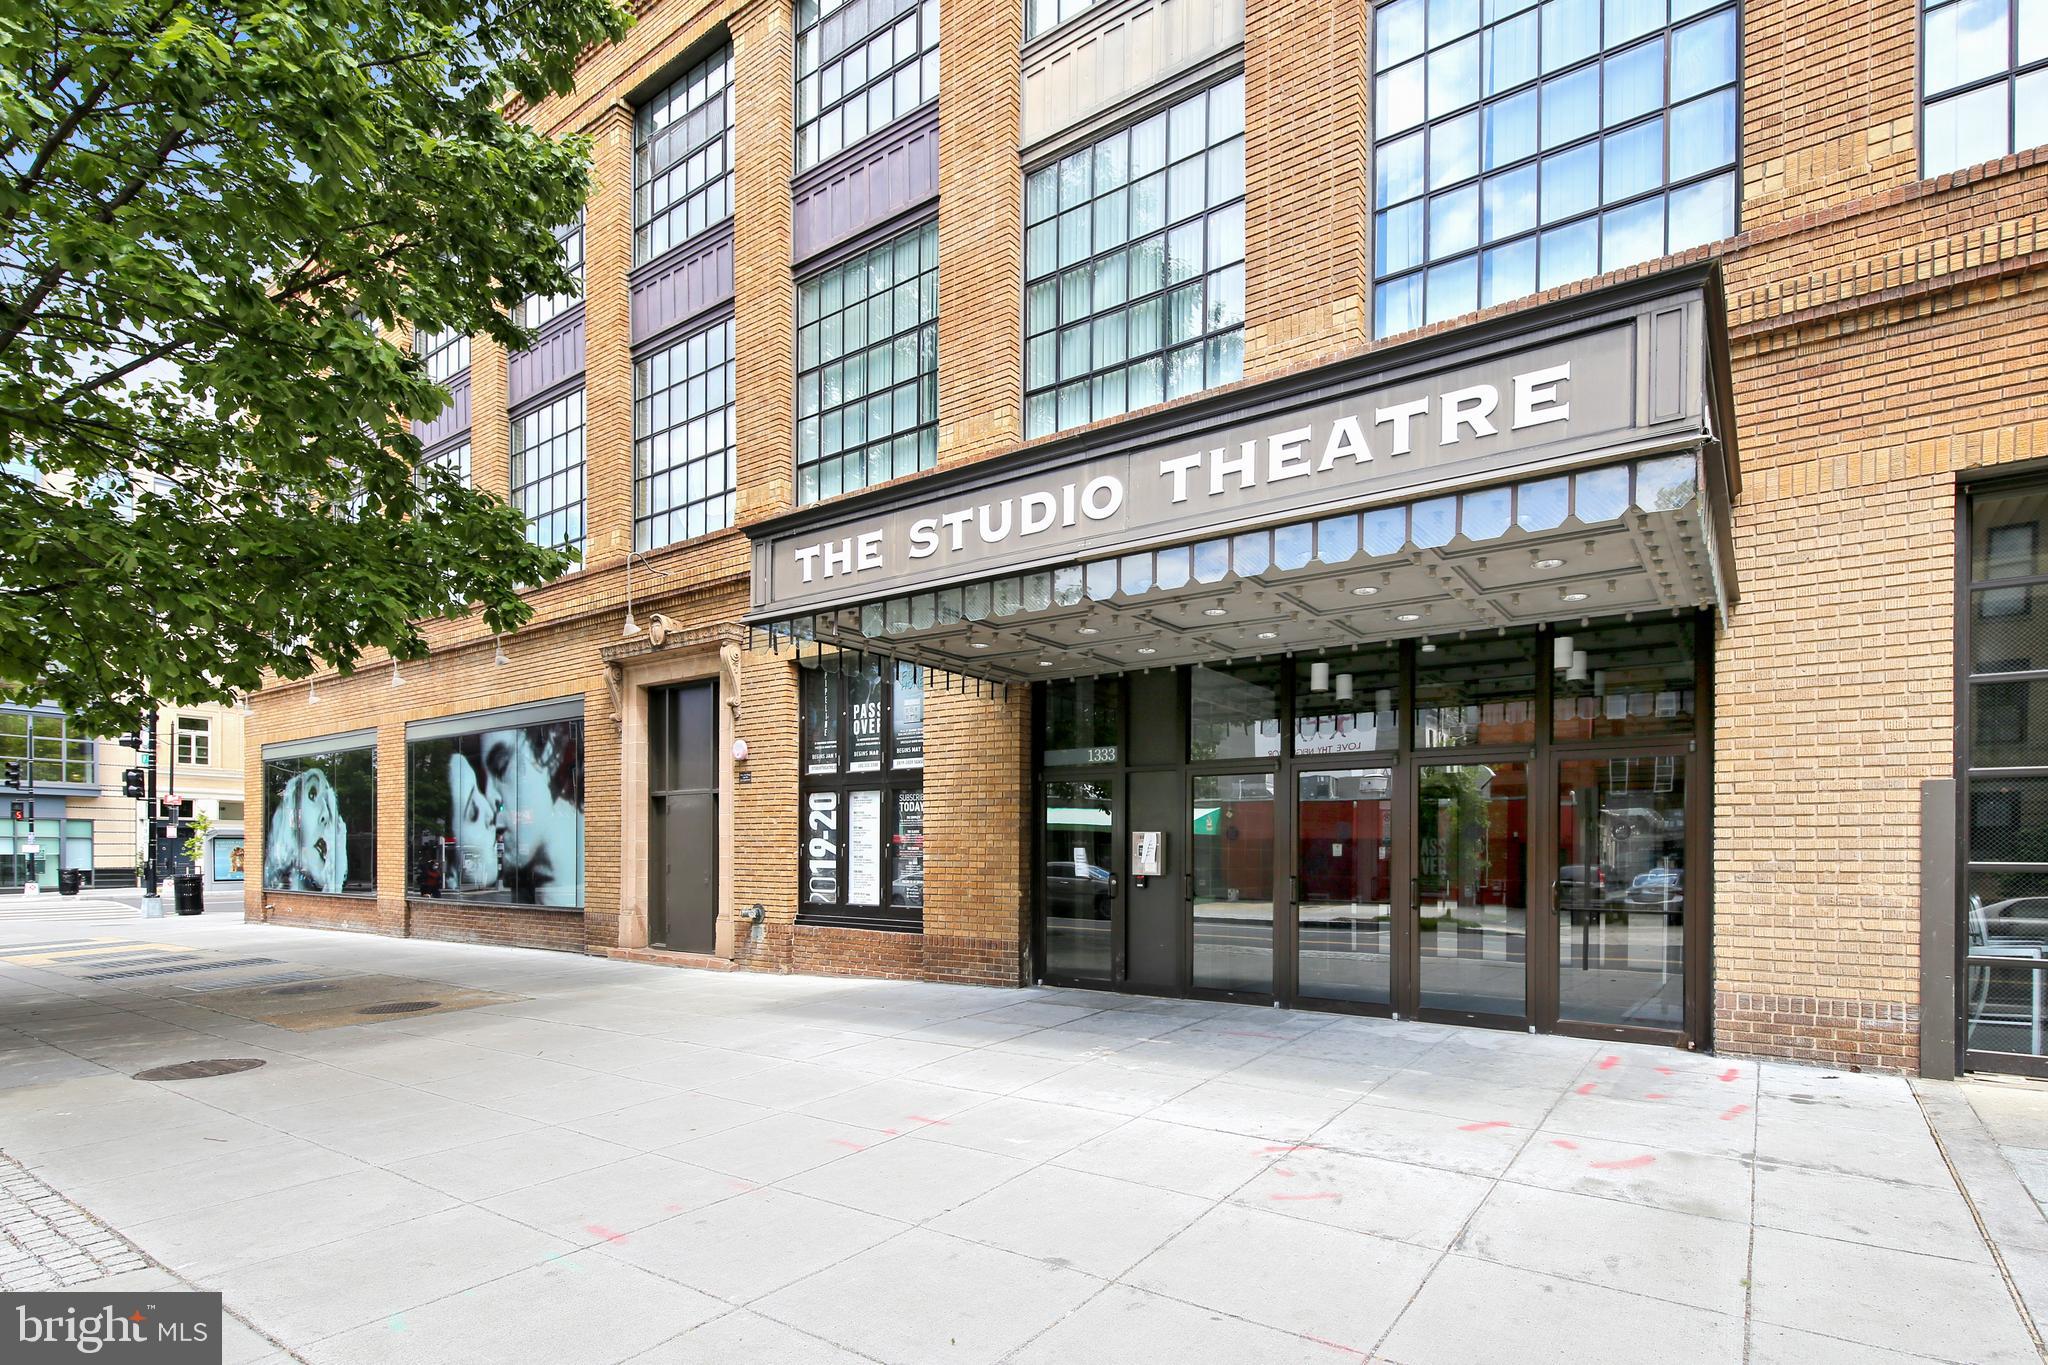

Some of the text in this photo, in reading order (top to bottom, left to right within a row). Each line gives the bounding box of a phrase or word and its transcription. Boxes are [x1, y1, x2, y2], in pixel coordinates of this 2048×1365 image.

[795, 360, 1571, 584] THE STUDIO THEATRE
[1088, 747, 1116, 762] 1333
[898, 801, 924, 812] TODAY
[809, 792, 837, 904] 2019-20
[1420, 837, 1447, 856] ASS
[1420, 856, 1447, 875] VER
